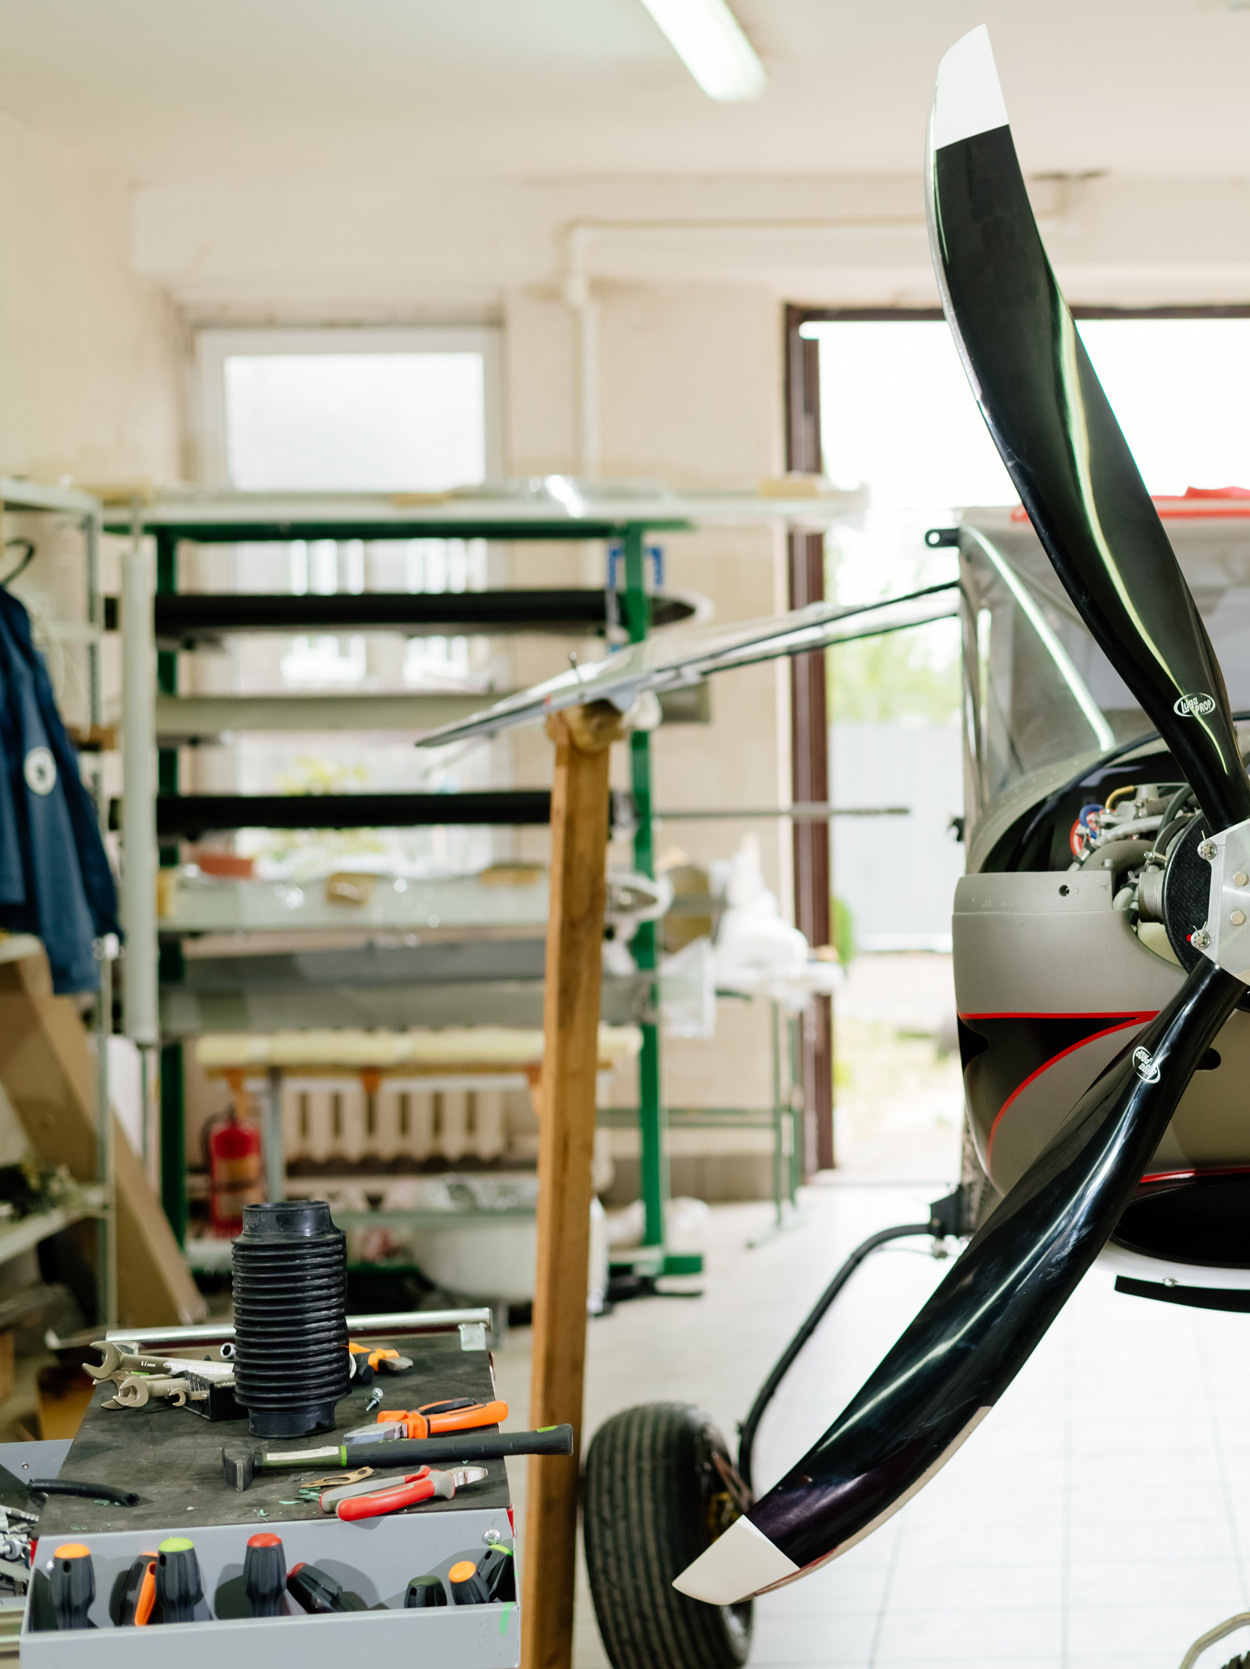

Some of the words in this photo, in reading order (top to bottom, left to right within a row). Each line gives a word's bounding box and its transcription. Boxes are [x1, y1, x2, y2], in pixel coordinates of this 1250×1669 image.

[1181, 697, 1199, 713] Luga
[1195, 699, 1212, 715] PROP
[1135, 1050, 1153, 1065] PROP
